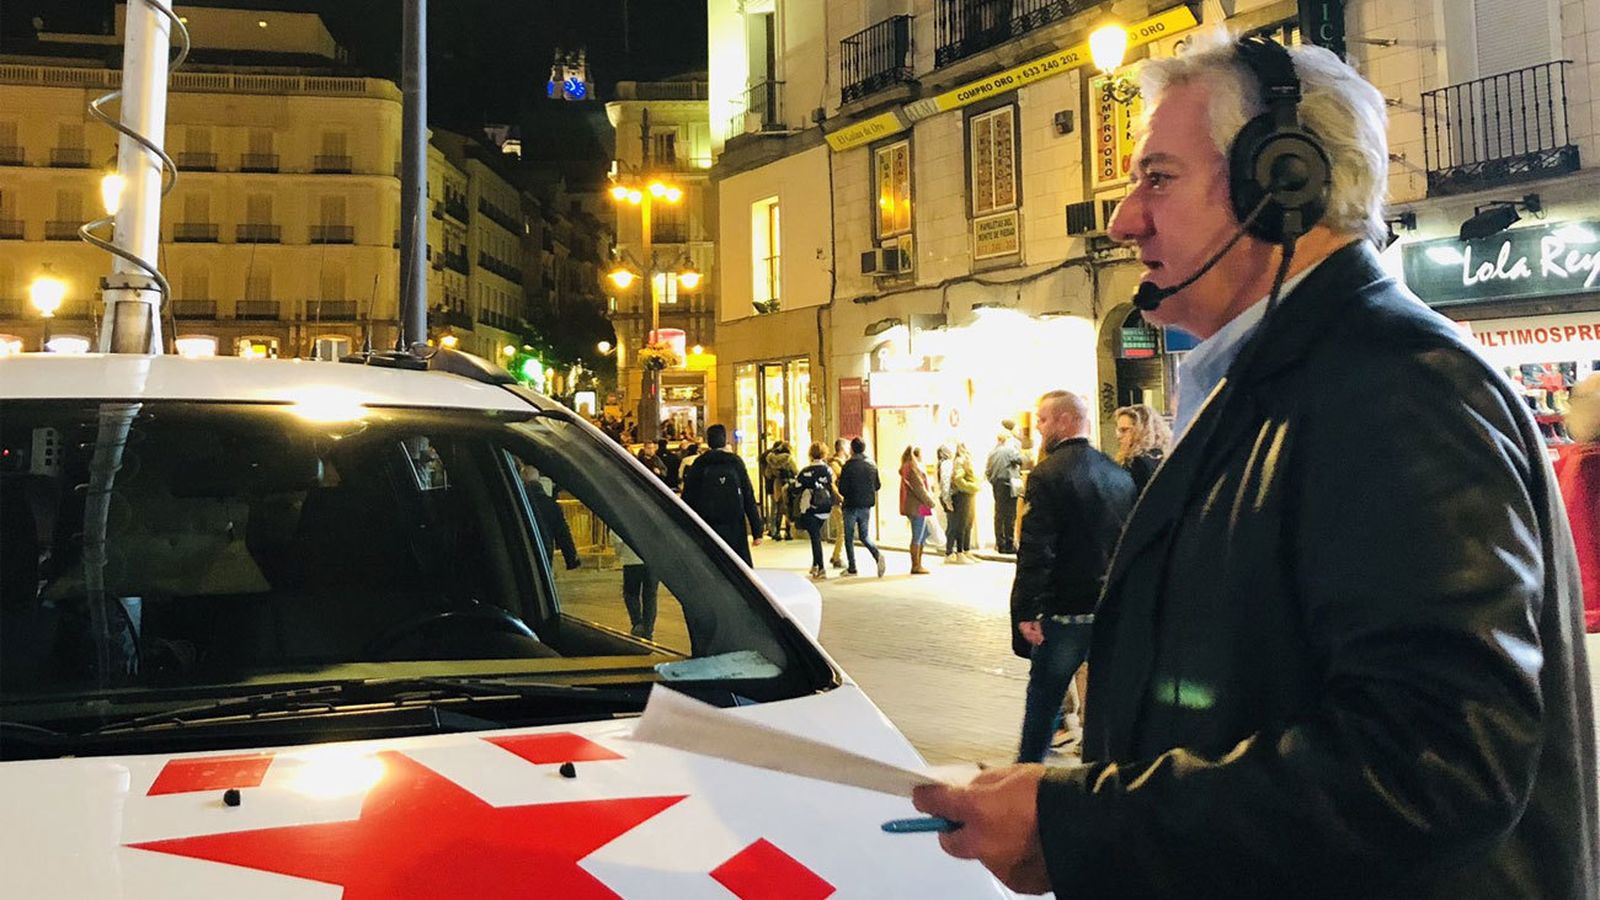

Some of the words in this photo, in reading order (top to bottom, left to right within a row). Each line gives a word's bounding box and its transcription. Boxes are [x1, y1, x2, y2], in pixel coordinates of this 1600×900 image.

[957, 83, 993, 101] COMPRO
[994, 75, 1014, 88] ORO
[1022, 66, 1041, 78] 633
[1042, 60, 1059, 72] 240
[1061, 53, 1079, 65] 202
[1140, 22, 1166, 37] ORO
[1103, 147, 1113, 177] ORO
[1463, 240, 1532, 286] Lola
